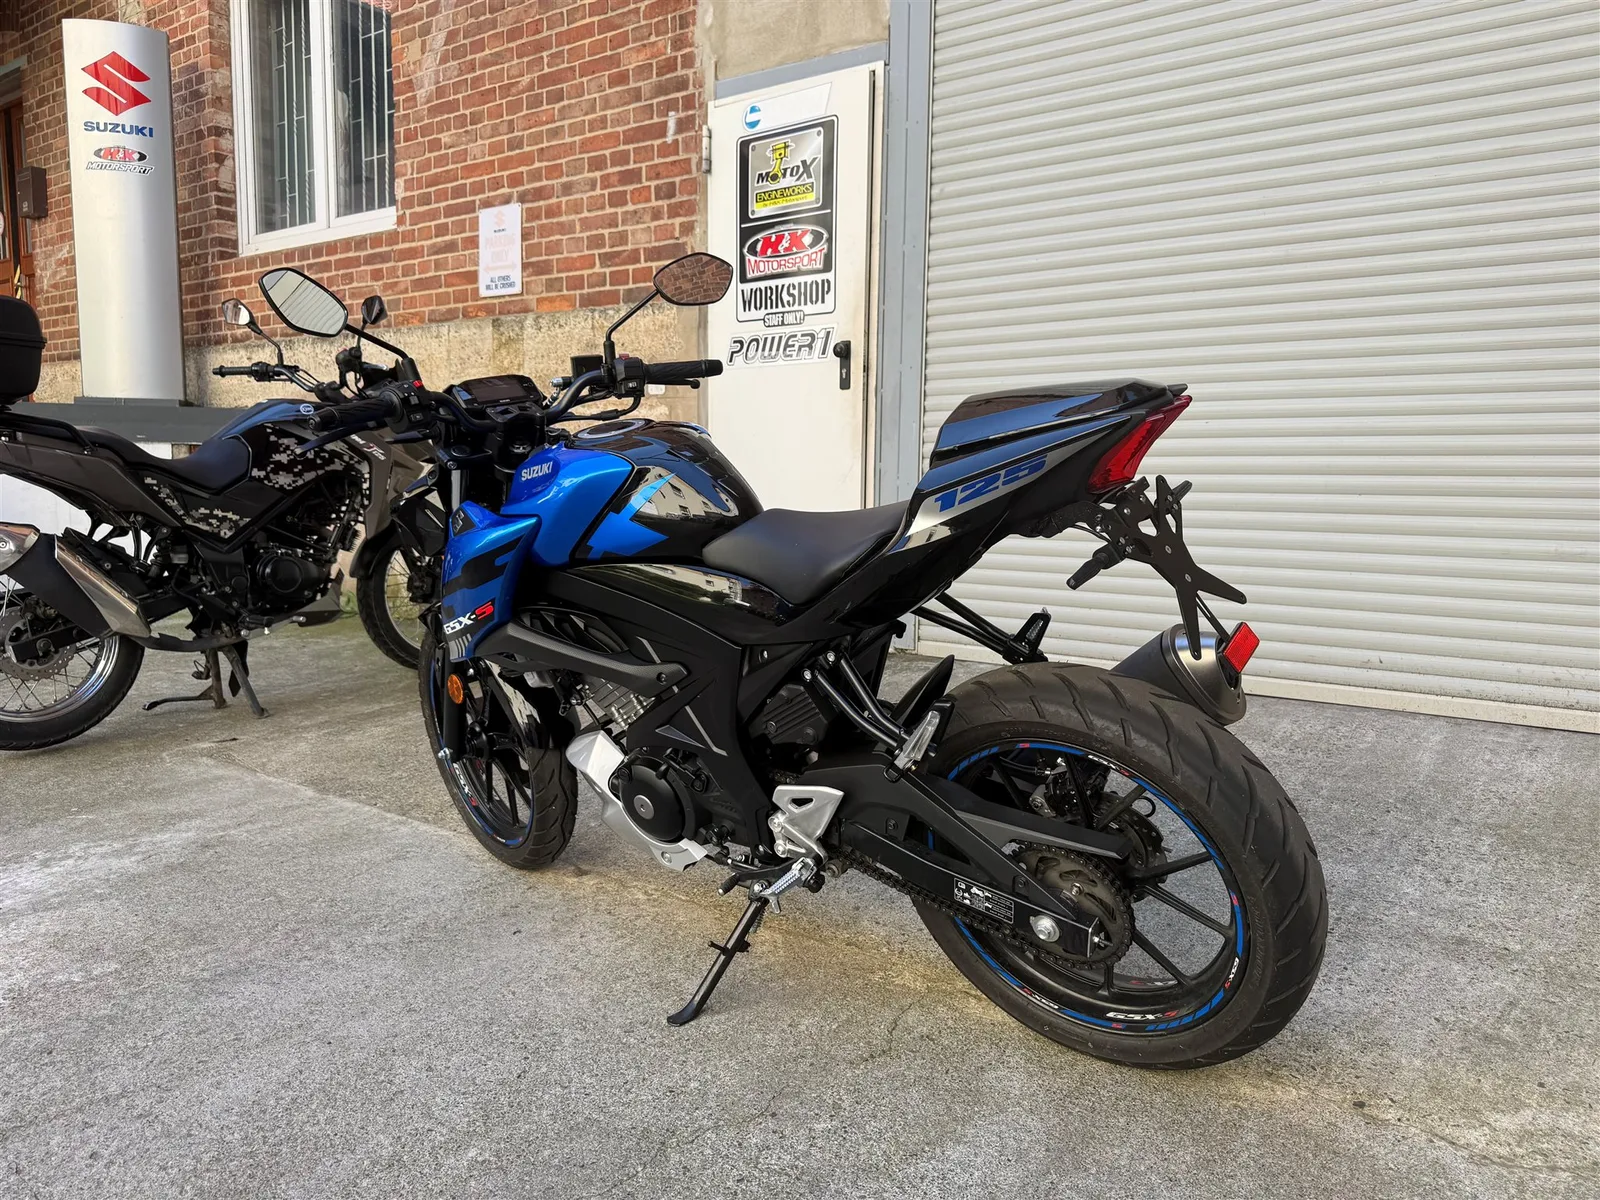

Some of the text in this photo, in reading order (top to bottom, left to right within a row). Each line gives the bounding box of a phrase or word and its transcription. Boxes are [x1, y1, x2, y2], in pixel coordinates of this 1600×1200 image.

[84, 121, 154, 137] SUZUKI
[86, 161, 154, 175] MOTORSPORT
[757, 184, 813, 202] ENGINEWORKS
[757, 229, 812, 257] H&K
[747, 247, 826, 277] MOTORSPORT
[500, 281, 516, 289] CRUSHED
[741, 278, 831, 312] WORKSHOP
[764, 311, 804, 326] STAFF ONLY!
[727, 328, 834, 365] POWER1
[521, 461, 553, 481] SUZUKI
[934, 454, 1048, 512] 125
